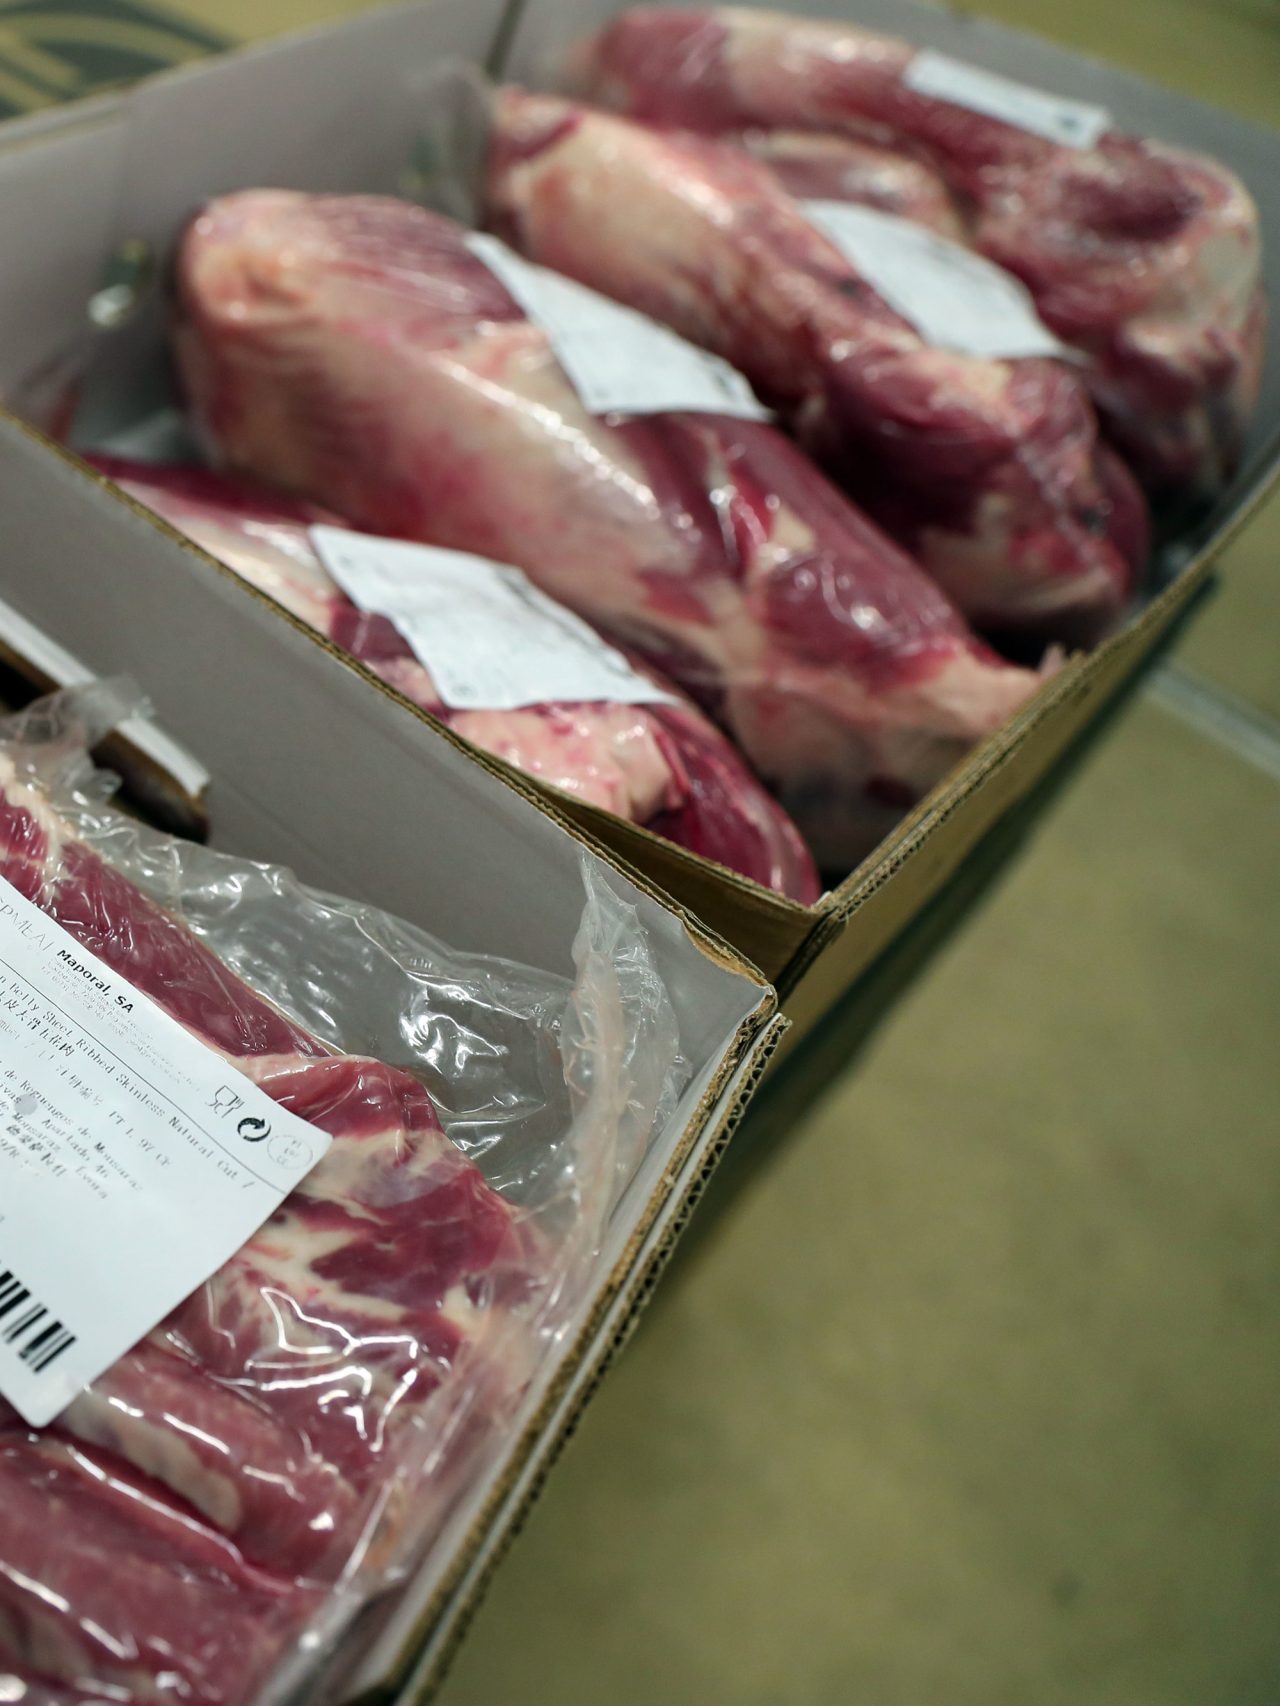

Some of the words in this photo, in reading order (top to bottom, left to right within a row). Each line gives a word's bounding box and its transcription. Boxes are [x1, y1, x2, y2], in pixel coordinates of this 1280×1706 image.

[56, 949, 111, 996] Maporal,
[113, 994, 134, 1013] SA
[3, 1069, 17, 1080] de
[19, 1079, 70, 1124] Reguengos
[8, 982, 39, 1011] Belly
[41, 1010, 73, 1037] Sheet
[75, 1037, 115, 1074] Ribbed
[115, 1073, 165, 1116] Skinless
[168, 1115, 214, 1158] Natural
